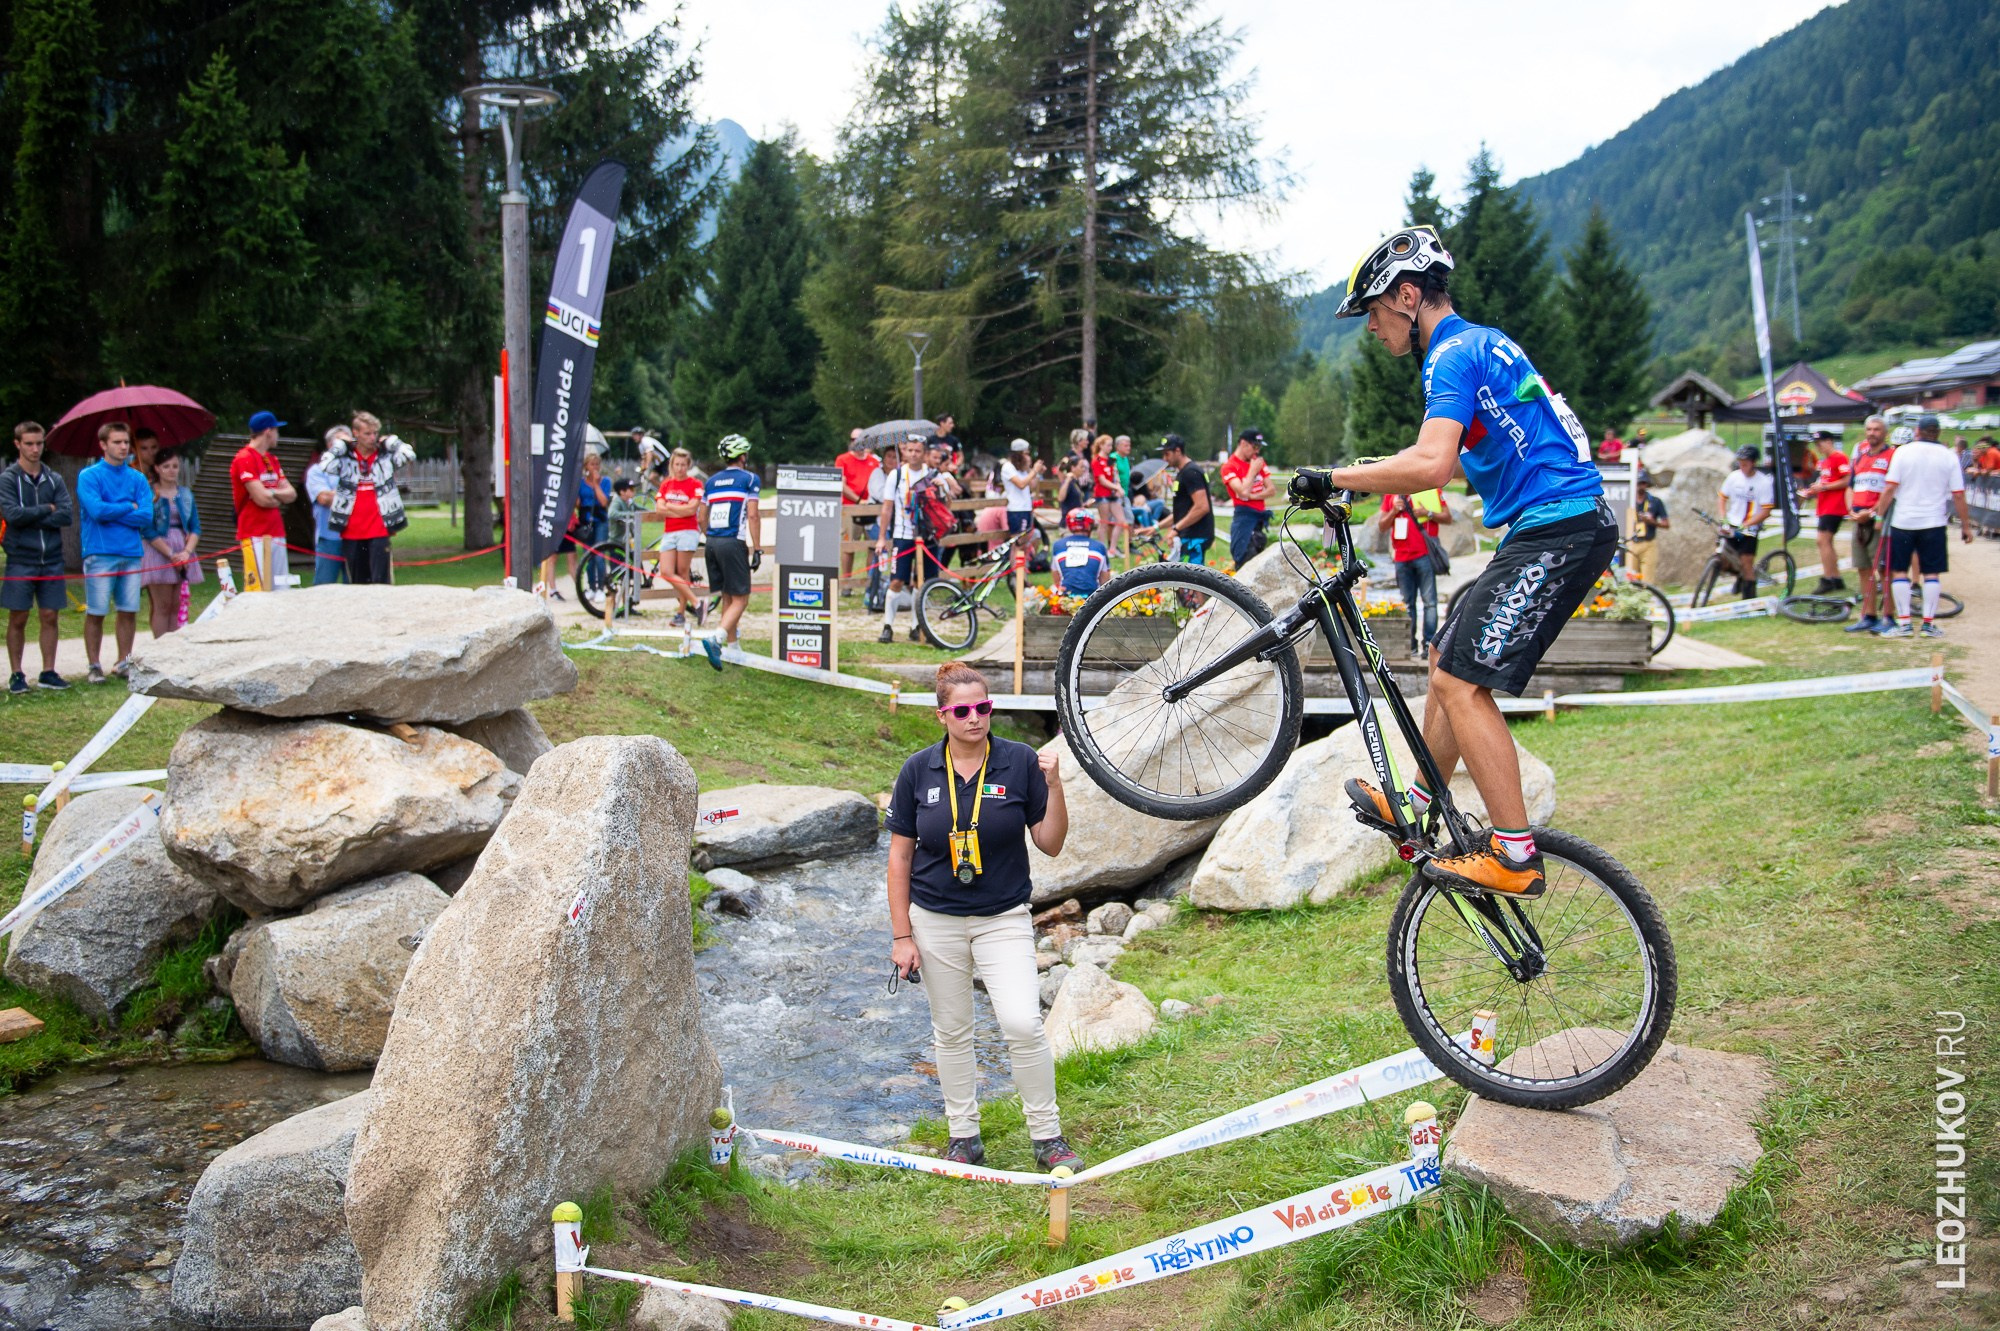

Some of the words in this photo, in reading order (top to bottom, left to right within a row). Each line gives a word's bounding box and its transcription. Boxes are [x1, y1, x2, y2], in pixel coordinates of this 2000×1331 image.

[576, 227, 597, 298] 1
[1373, 270, 1391, 291] urge
[561, 308, 585, 335] UCI
[537, 357, 574, 539] #TrialsWorlds
[712, 511, 728, 520] 202
[780, 499, 838, 518] START
[799, 524, 815, 562] 1
[798, 577, 819, 586] UCI
[795, 612, 816, 621] UCI
[1480, 563, 1547, 656] OZONYS
[796, 638, 817, 647] UCI
[1021, 1289, 1062, 1307] Val
[1064, 1283, 1081, 1299] di
[1078, 1267, 1135, 1294] Sole
[1144, 1226, 1254, 1273] TRENTINO
[1272, 1204, 1317, 1232] Val
[1318, 1203, 1336, 1221] di
[1331, 1183, 1393, 1216] Sole
